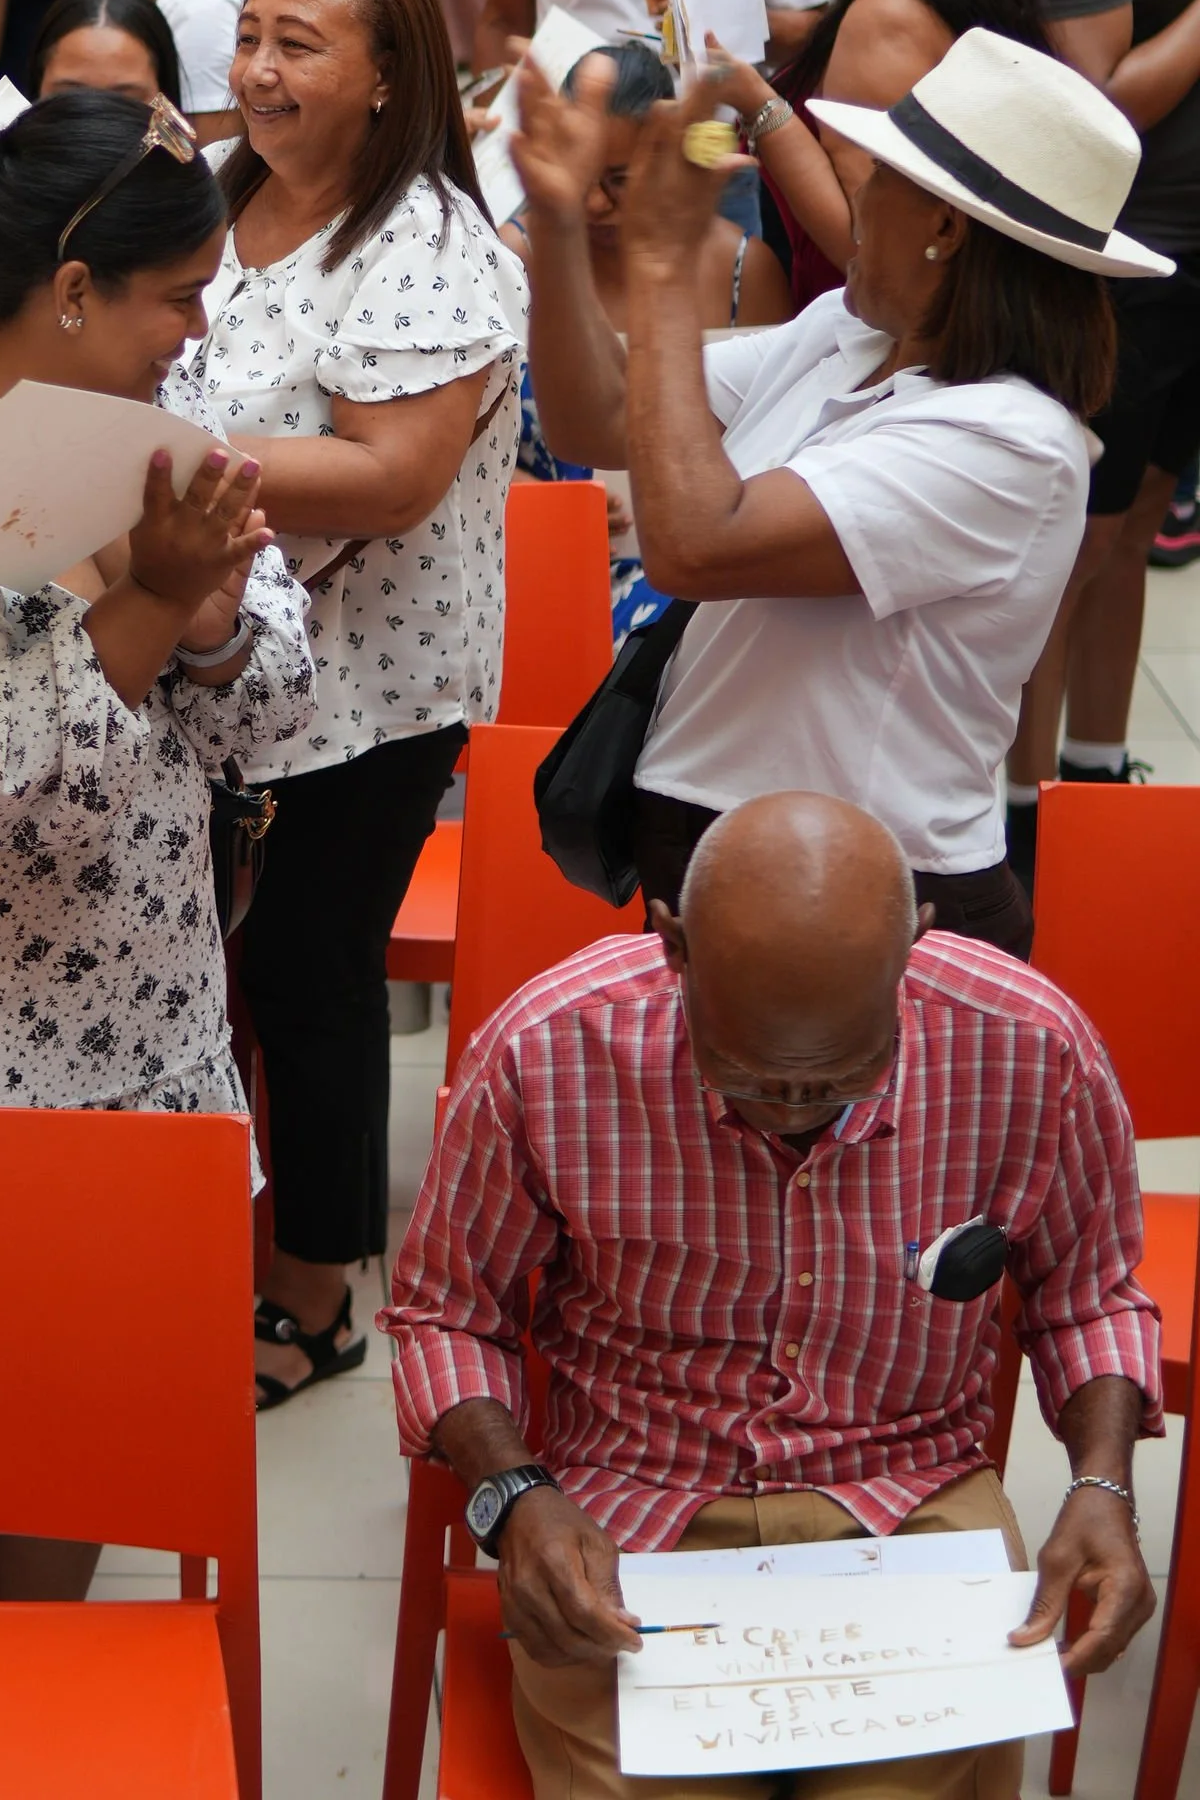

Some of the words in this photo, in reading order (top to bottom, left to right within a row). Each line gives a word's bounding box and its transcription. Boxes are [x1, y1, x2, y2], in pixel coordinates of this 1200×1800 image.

[693, 1629, 728, 1646] EL
[673, 1691, 726, 1712] EL
[749, 1680, 876, 1707] CAFE
[761, 1705, 801, 1727] ES
